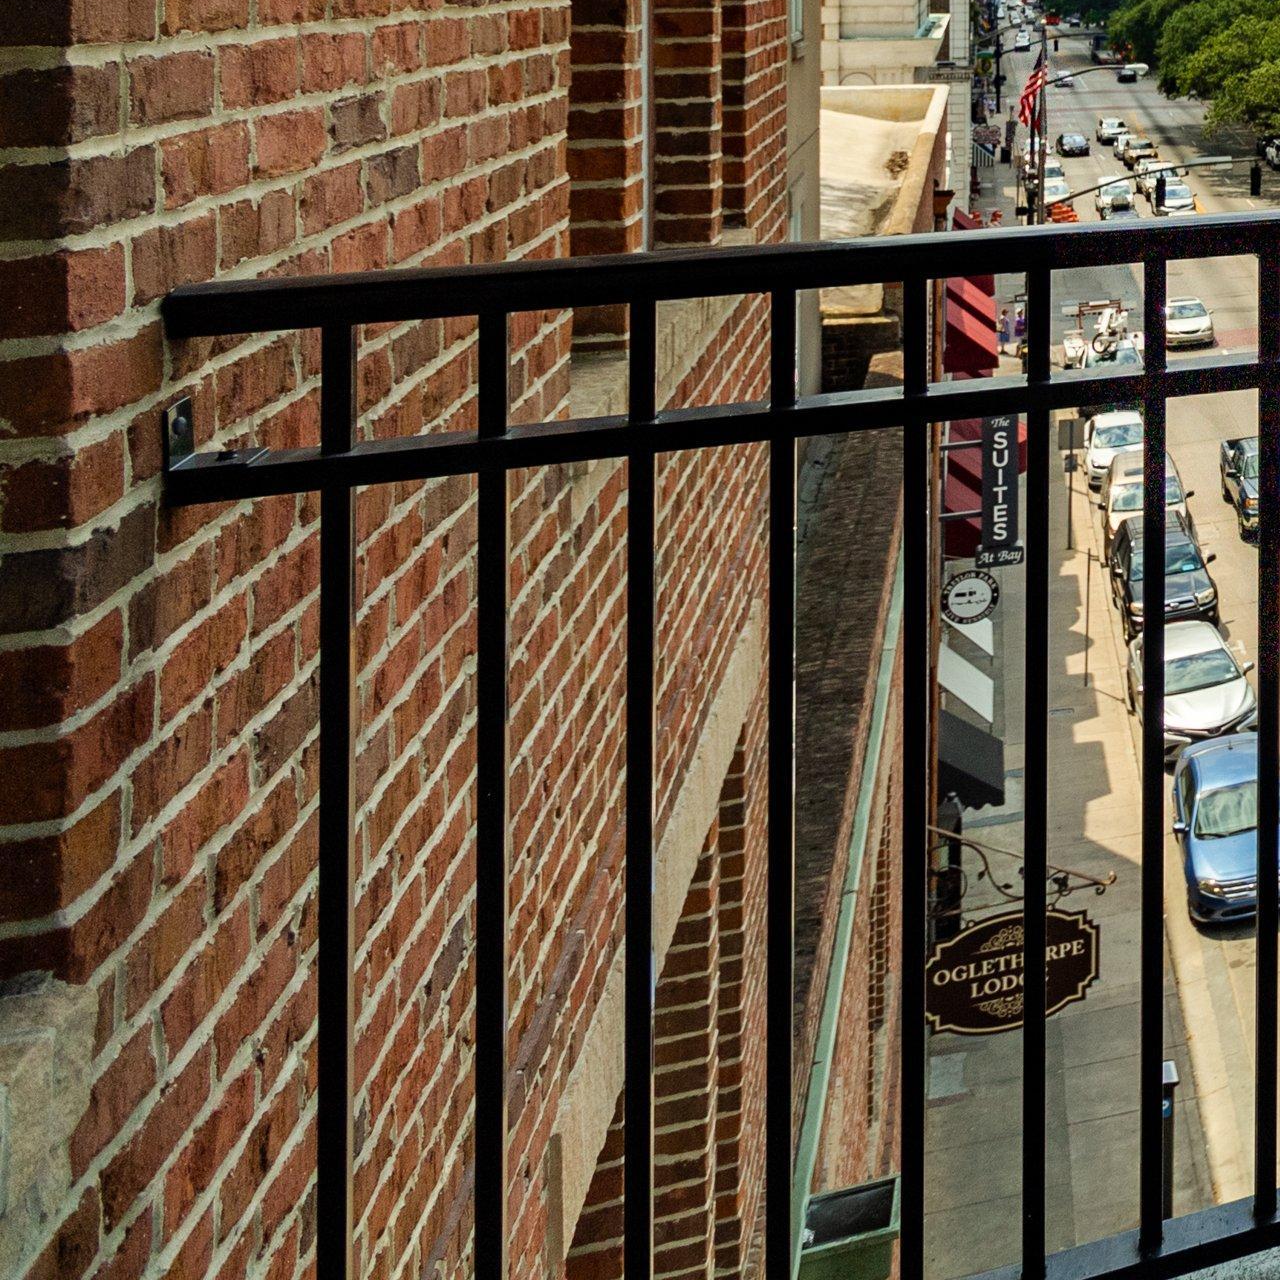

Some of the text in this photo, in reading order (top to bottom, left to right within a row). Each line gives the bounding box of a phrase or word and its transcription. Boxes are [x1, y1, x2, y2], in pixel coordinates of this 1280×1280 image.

[991, 416, 1010, 428] The
[992, 431, 1009, 541] SUITES
[978, 550, 1022, 564] At Bay
[933, 939, 1085, 986] OGLETHRPE
[970, 966, 1050, 999] LOD
